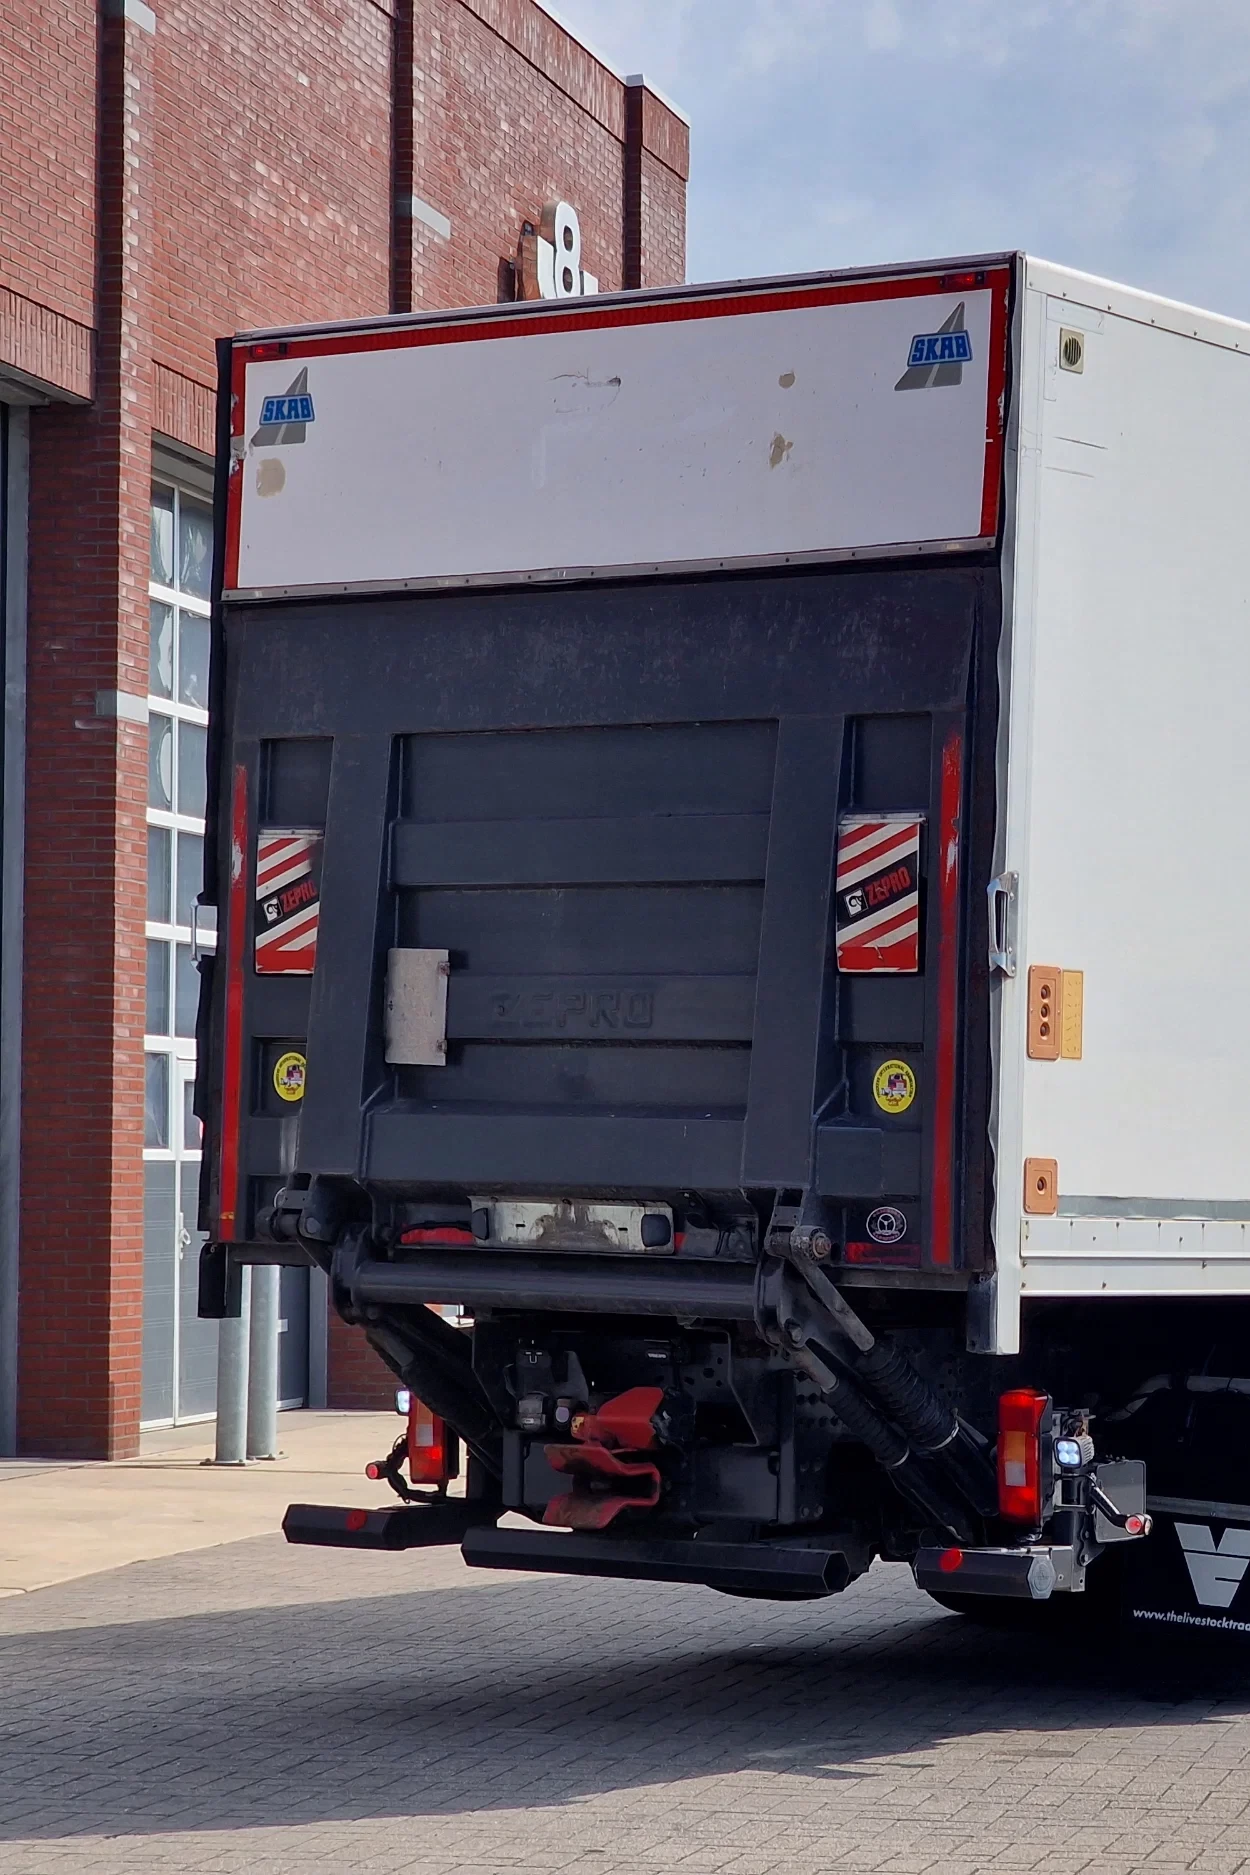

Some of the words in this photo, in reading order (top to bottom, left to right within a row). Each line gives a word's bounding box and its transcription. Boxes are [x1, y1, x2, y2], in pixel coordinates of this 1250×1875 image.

[911, 335, 968, 362] SKAB
[263, 397, 312, 422] SKAB
[865, 866, 912, 906] ZEPRO
